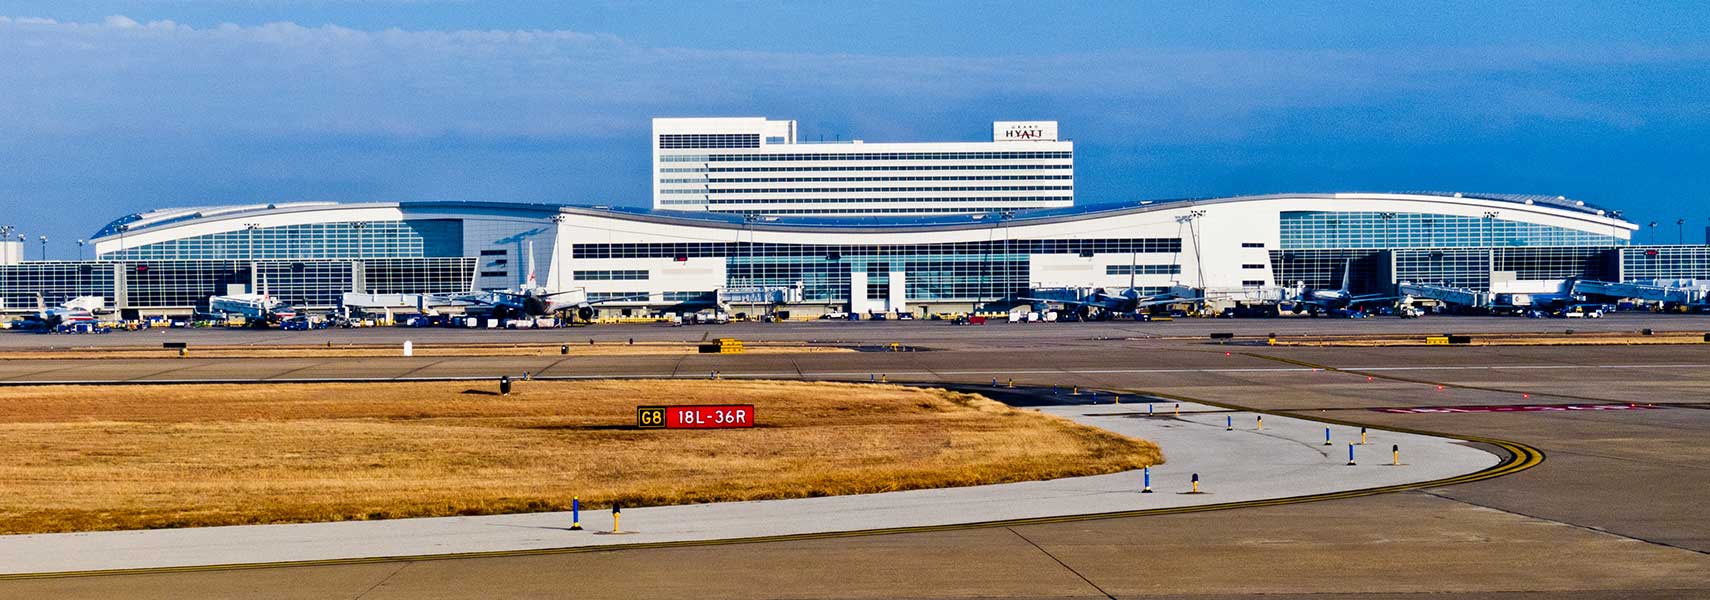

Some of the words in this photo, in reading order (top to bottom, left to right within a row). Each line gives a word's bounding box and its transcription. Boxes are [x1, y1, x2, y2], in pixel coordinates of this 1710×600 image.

[1006, 129, 1043, 139] HYATT
[641, 410, 662, 425] G8
[678, 409, 746, 424] 18L-36R
